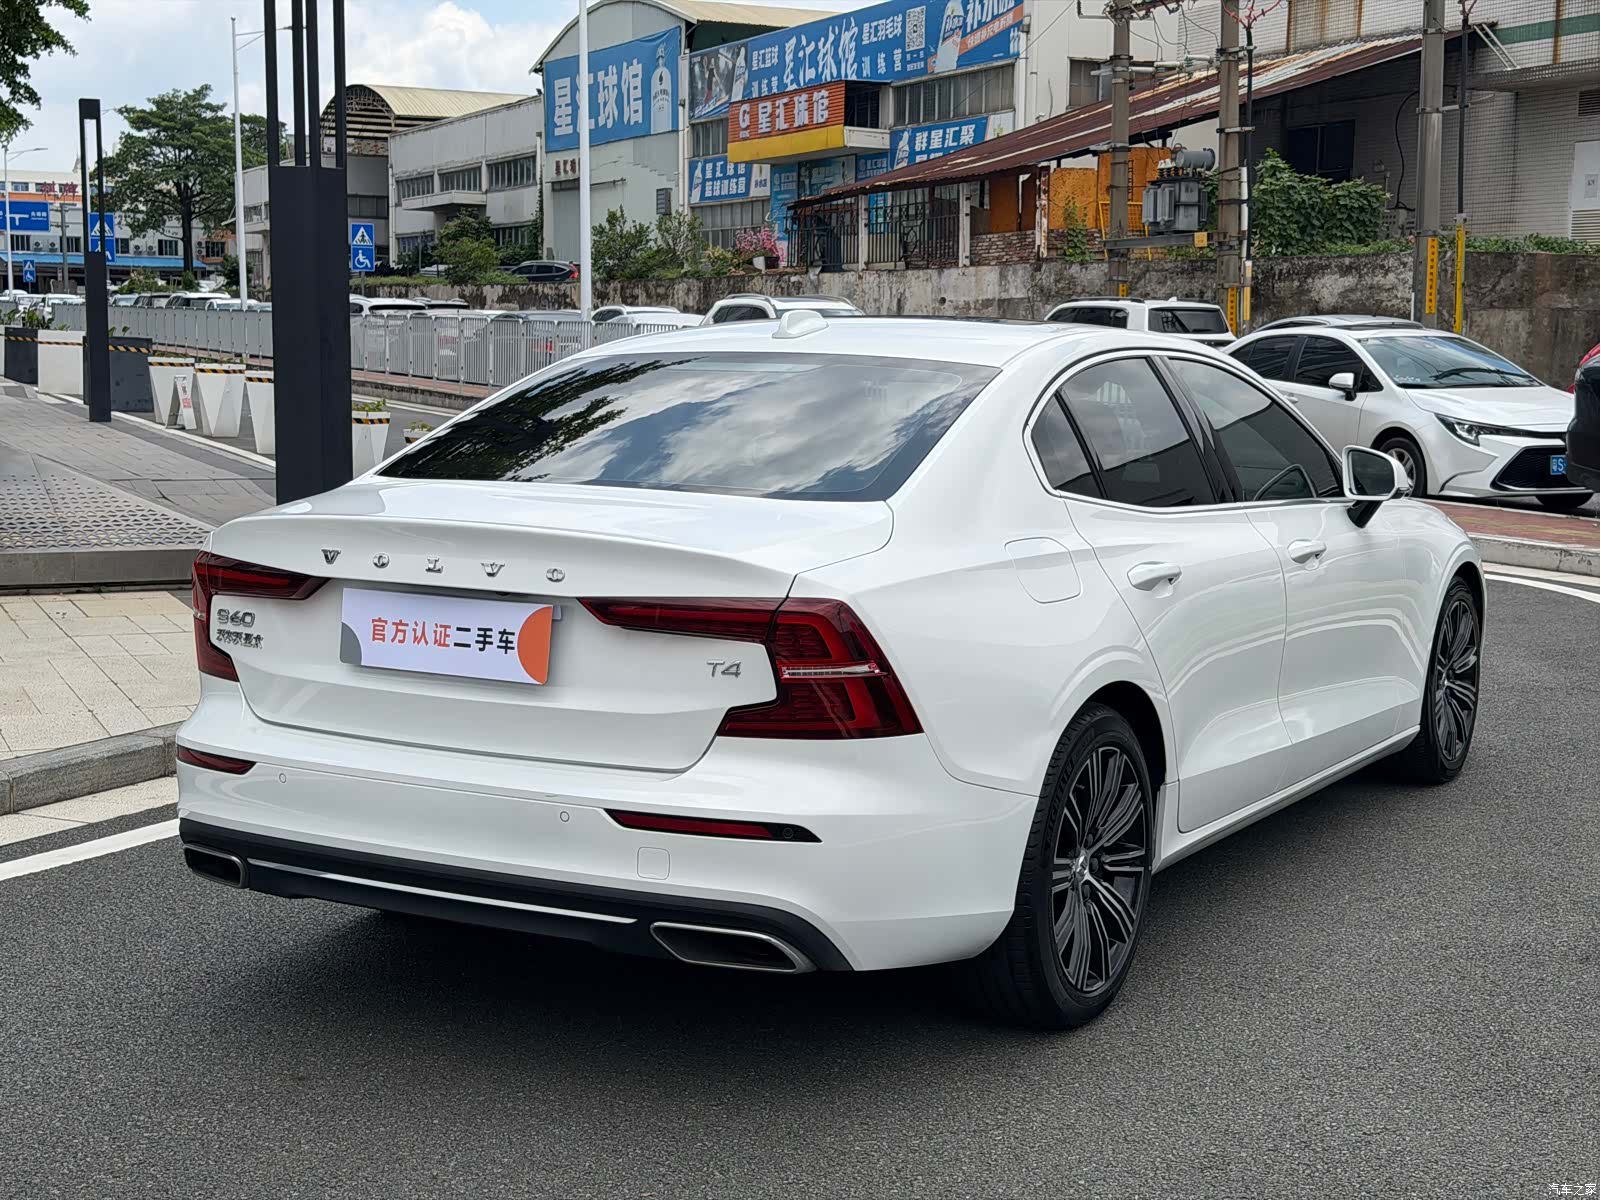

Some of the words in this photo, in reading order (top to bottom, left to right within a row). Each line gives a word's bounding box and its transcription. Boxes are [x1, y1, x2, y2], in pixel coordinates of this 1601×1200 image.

[862, 13, 903, 45] 星汇羽毛球
[752, 44, 779, 71] 星汇篮球
[784, 15, 859, 91] 星汇球馆
[862, 48, 903, 78] 训练营
[554, 58, 643, 136] 星汇球馆
[758, 89, 830, 134] 星汇球馆
[915, 124, 975, 151] 群星汇聚
[704, 177, 746, 197] 篮球训练营
[320, 548, 566, 583] VOLVO
[217, 608, 256, 628] S60
[370, 616, 516, 655] 官方认证二手车
[706, 659, 742, 679] T4
